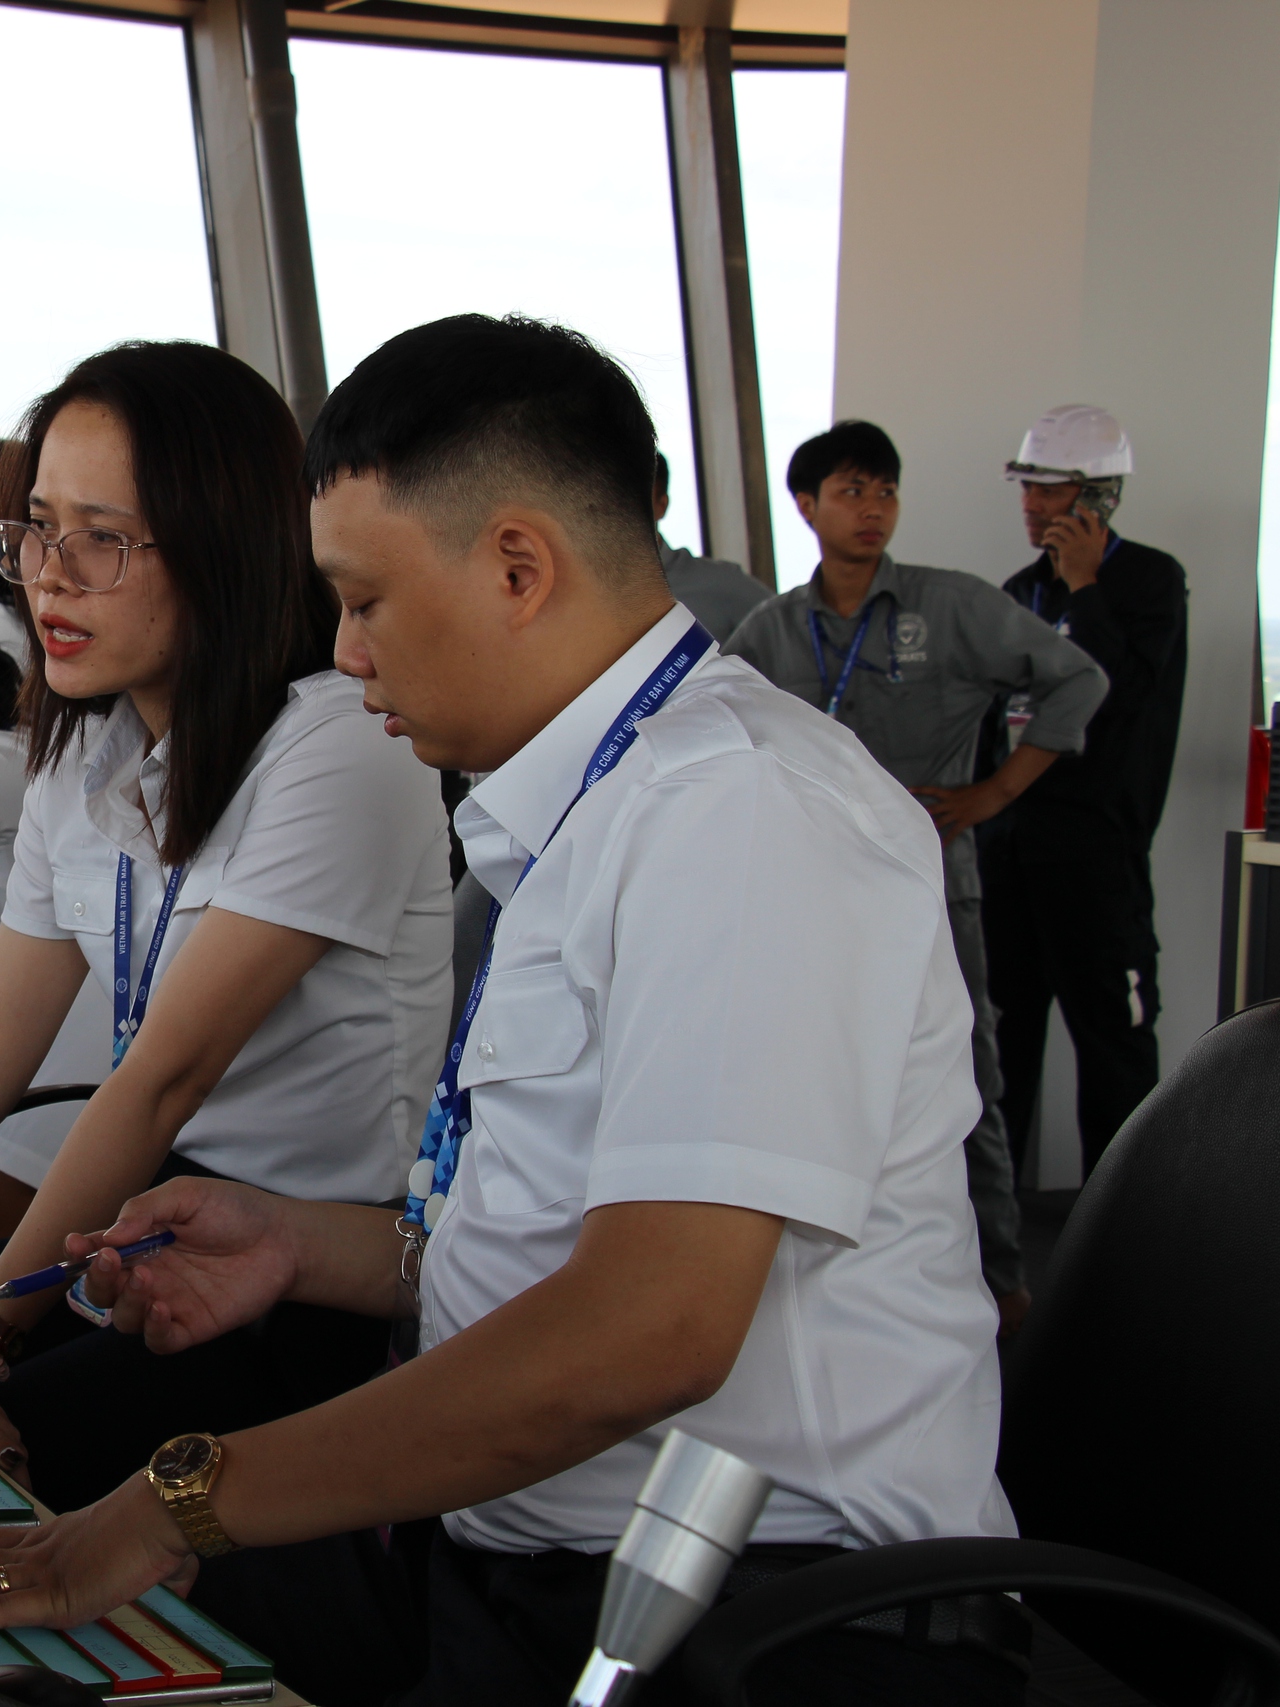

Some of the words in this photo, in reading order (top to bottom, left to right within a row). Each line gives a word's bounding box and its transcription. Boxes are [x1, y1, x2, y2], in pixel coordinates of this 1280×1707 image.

[598, 743, 619, 768] CÔNG
[613, 730, 627, 744] TY
[622, 708, 645, 733] QUẢN
[648, 681, 665, 700] BAY
[660, 666, 679, 684] VIỆT
[673, 653, 690, 670] NAM
[119, 880, 128, 908] TRAFFIC
[119, 909, 127, 923] AIR
[160, 921, 166, 930] TY
[118, 924, 127, 955] VIETNAM
